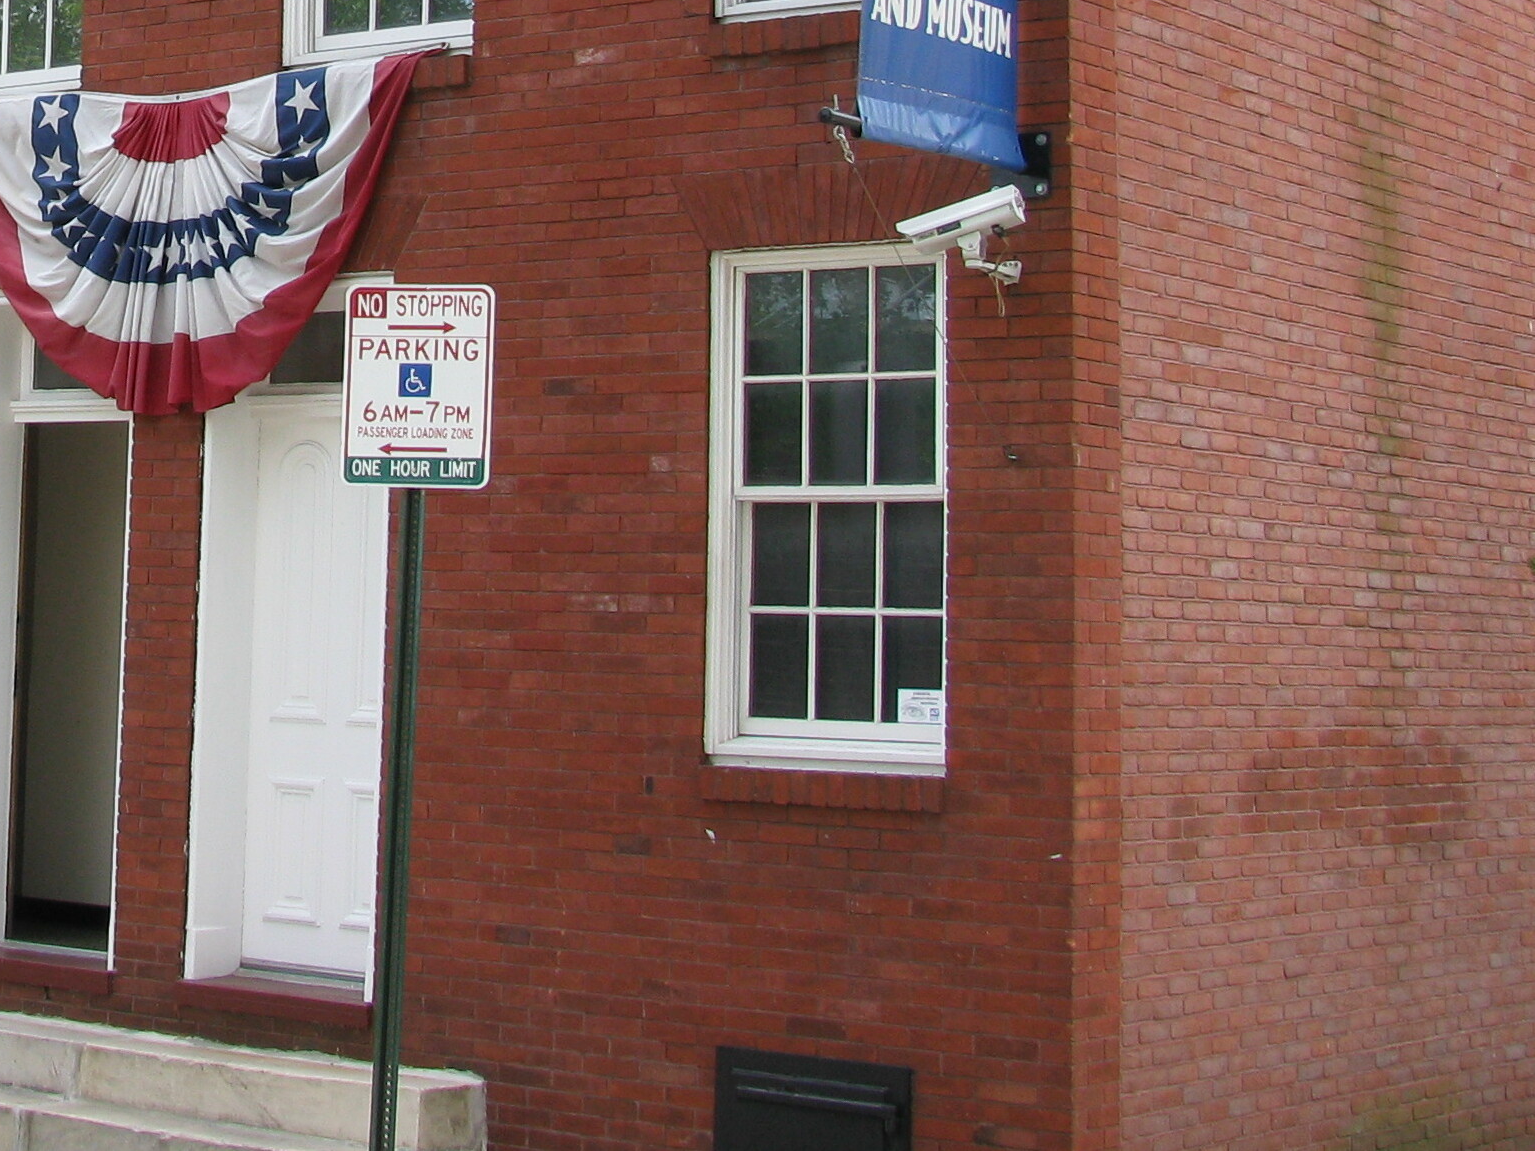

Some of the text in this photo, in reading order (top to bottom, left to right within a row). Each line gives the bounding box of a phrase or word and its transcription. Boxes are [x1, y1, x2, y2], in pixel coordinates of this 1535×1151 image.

[357, 293, 483, 317] NO STOPPING
[358, 339, 479, 361] PARKING
[357, 426, 474, 440] PASSENGER LOADING ZONE
[351, 459, 477, 479] ONE HOUR LIMIT
